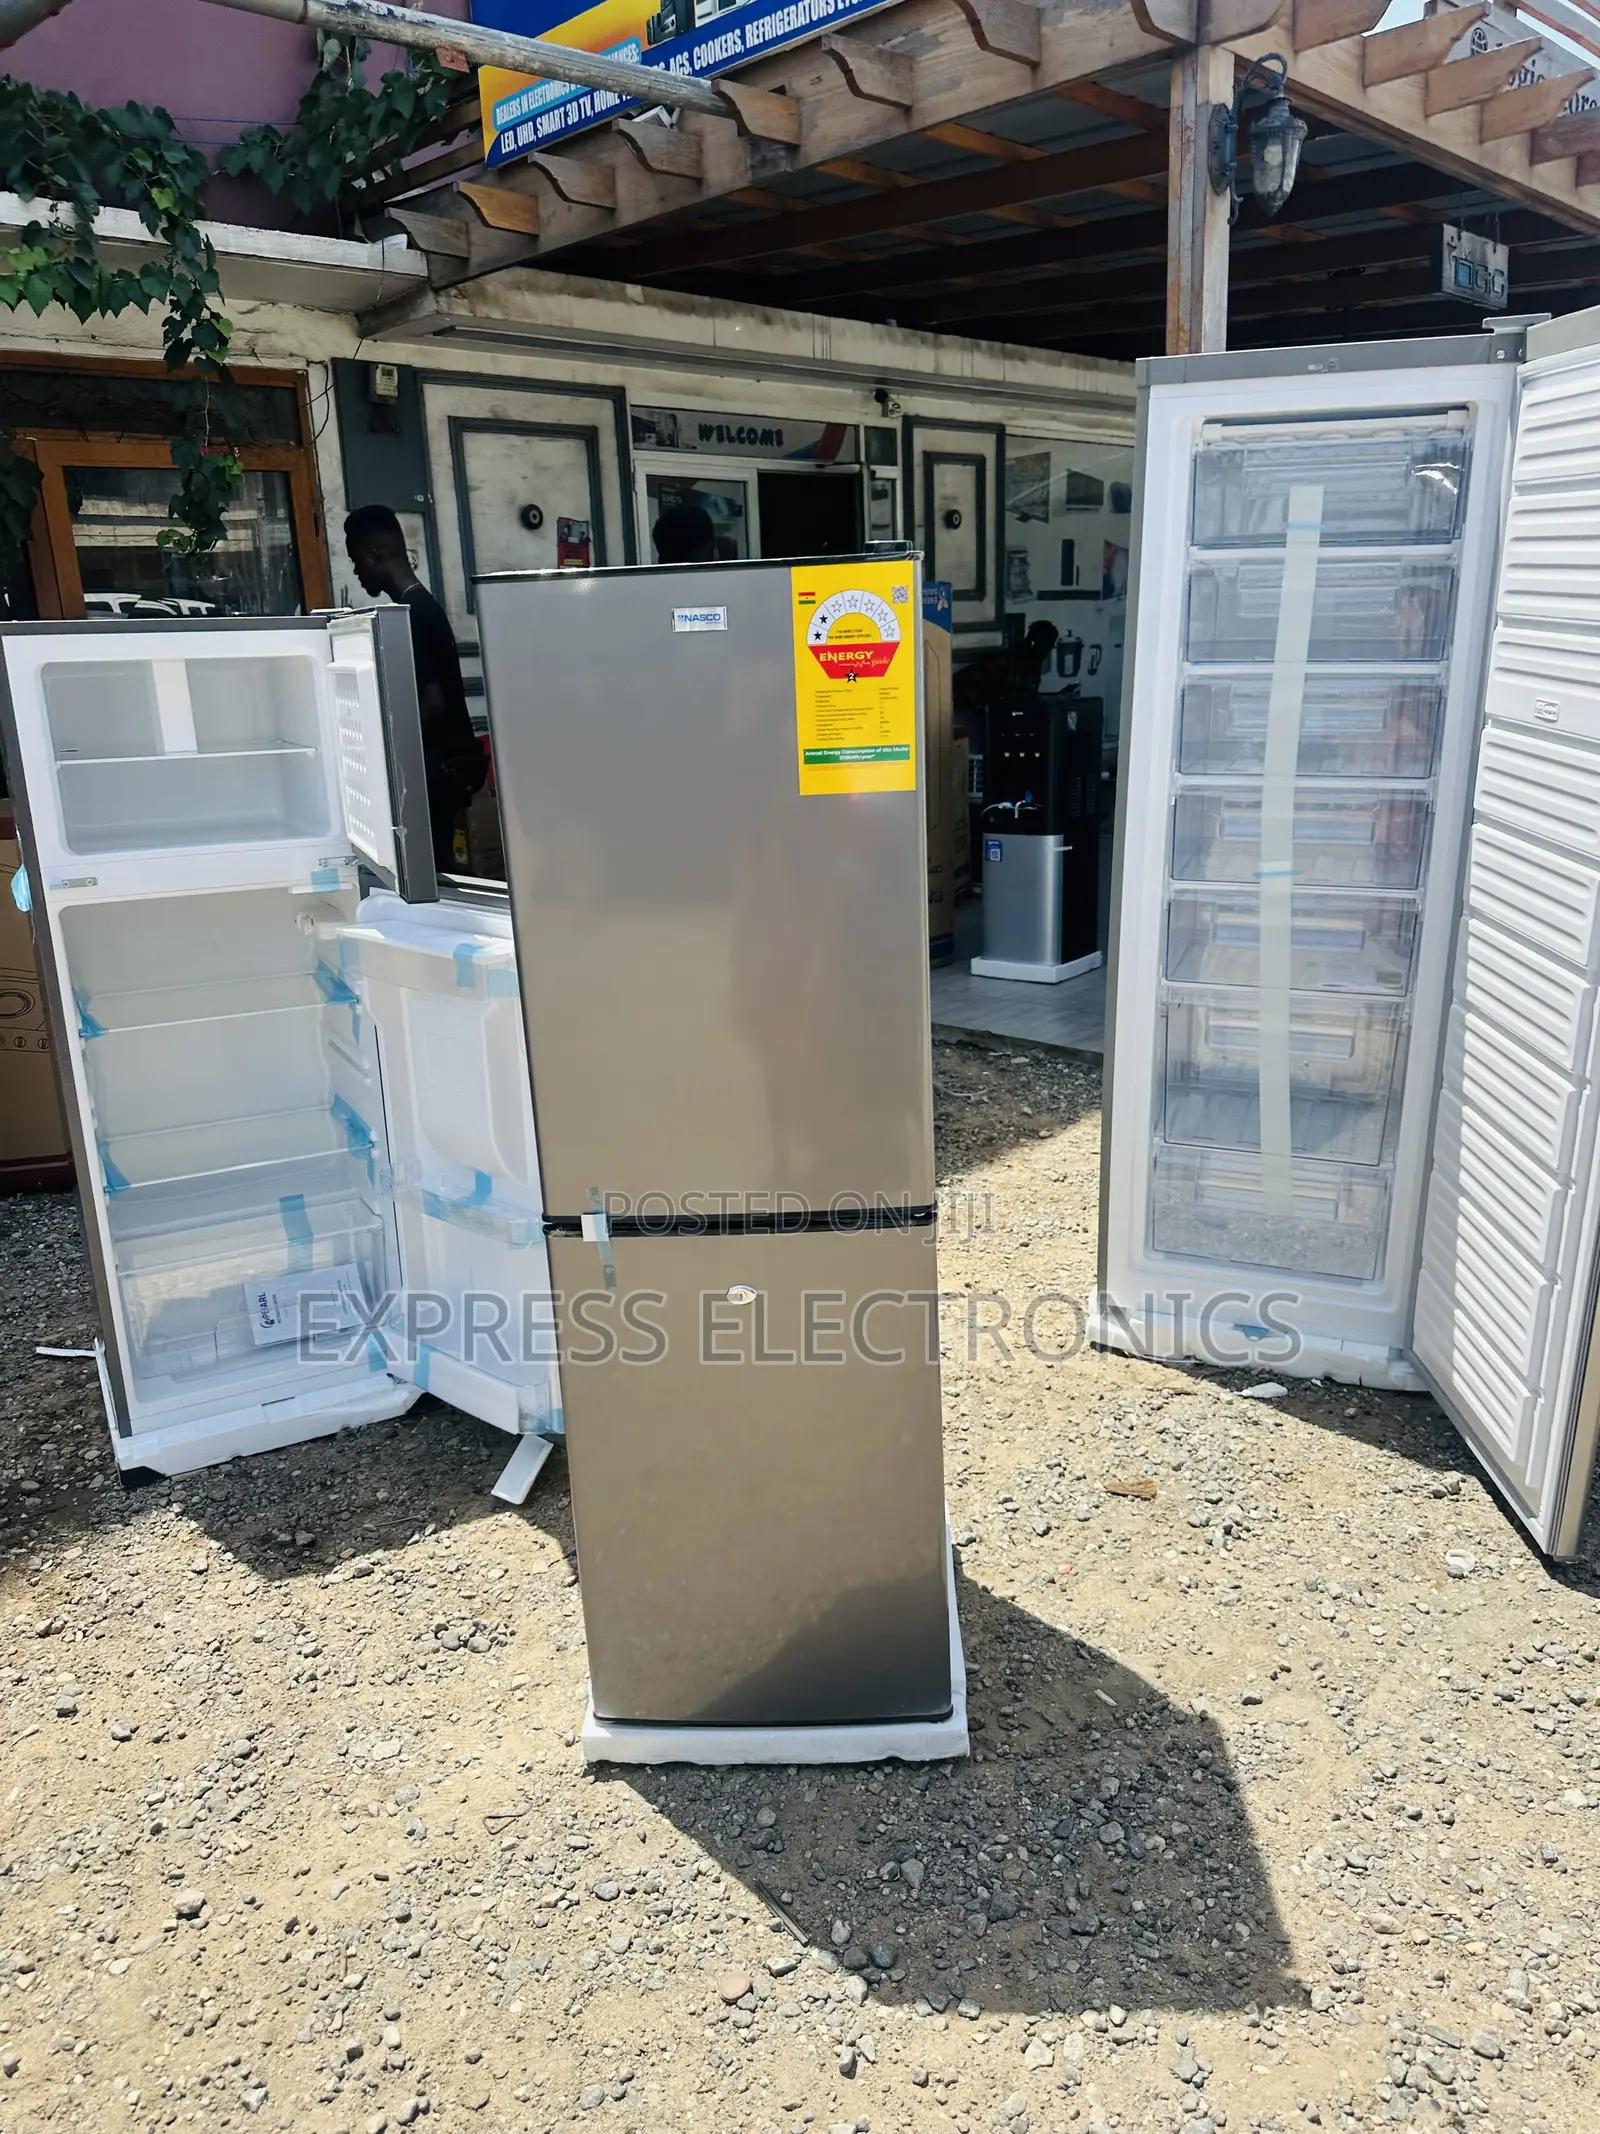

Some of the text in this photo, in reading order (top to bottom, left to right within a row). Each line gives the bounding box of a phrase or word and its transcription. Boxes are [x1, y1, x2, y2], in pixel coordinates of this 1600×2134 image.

[501, 130, 517, 154] LED,
[517, 121, 537, 147] UHD,
[536, 108, 566, 138] SMART
[566, 100, 580, 125] 3D
[579, 94, 594, 119] TV,
[593, 90, 620, 113] HOME
[669, 51, 693, 76] ACS,
[694, 29, 745, 71] COOKERS,
[745, 0, 836, 49] REFRIGERATORS
[496, 98, 521, 125] DEALERS
[521, 94, 529, 113] IN
[528, 80, 570, 111] ELECTRONICS
[698, 422, 784, 448] WELCOME
[684, 613, 722, 622] NASCO
[819, 650, 874, 664] ENERGY
[849, 672, 855, 680] 2
